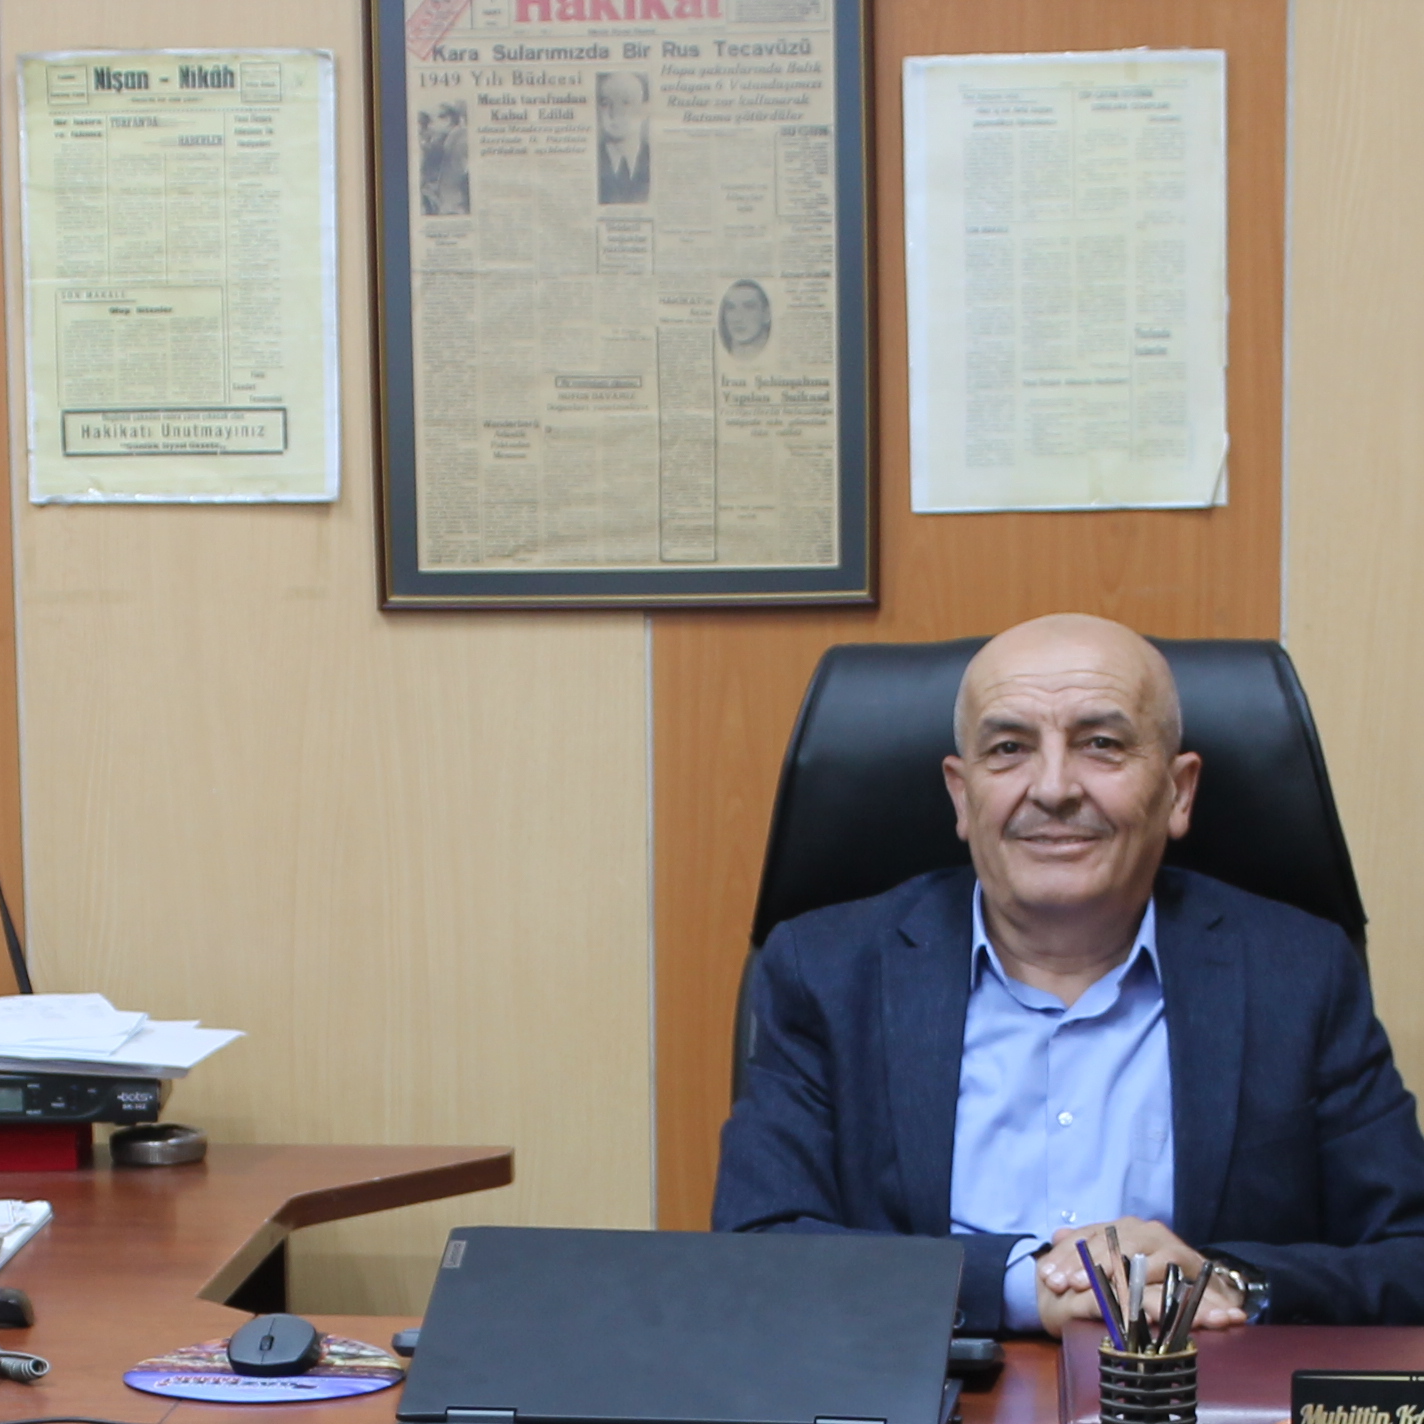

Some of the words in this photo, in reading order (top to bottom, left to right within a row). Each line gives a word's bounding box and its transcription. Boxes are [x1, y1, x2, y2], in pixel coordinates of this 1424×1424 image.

[432, 45, 479, 62] Kara
[493, 44, 609, 61] Sularımızda
[622, 41, 651, 59] Bir
[661, 41, 701, 58] Rus
[714, 37, 812, 56] Tecavüzü
[93, 66, 149, 92] Nişan
[178, 64, 235, 89] Nikâh
[419, 72, 461, 88] 1949
[471, 70, 503, 87] Yılı
[512, 69, 583, 87] Büdcesi
[477, 94, 517, 105] Meclis
[520, 93, 587, 105] tarafından
[490, 109, 528, 121] Kabul
[538, 108, 575, 120] Edildi
[81, 423, 152, 440] Hakikatı
[161, 422, 266, 440] Unutmayınız
